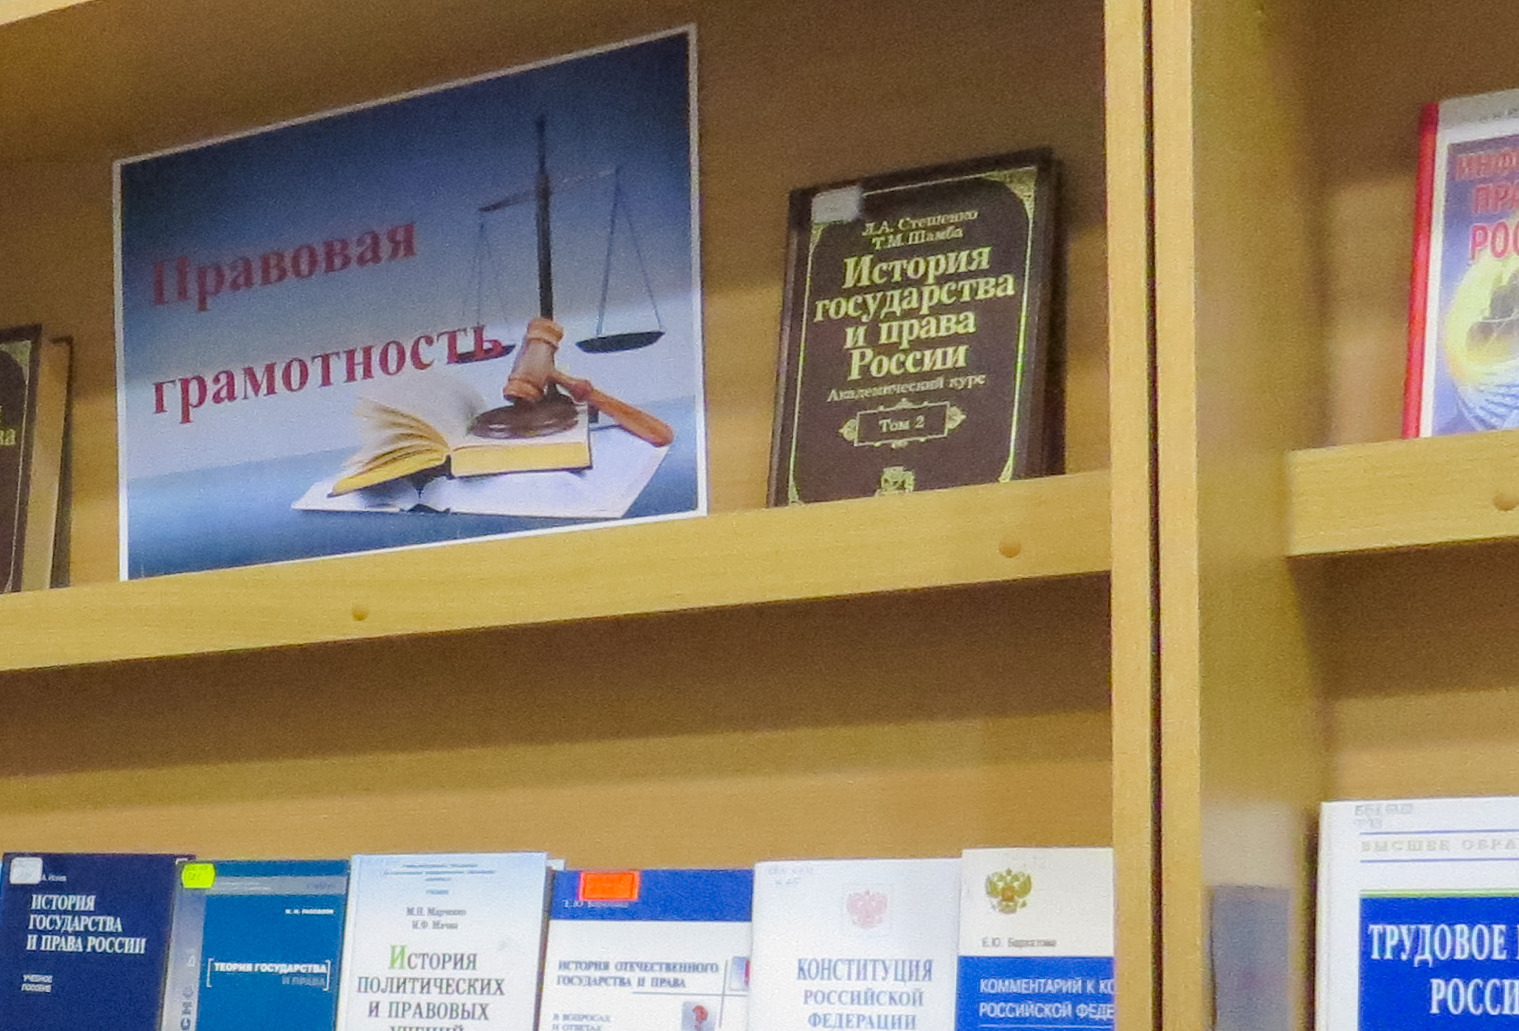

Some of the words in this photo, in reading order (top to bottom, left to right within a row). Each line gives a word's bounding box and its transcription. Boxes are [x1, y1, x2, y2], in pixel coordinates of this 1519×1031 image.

[152, 222, 417, 313] Правовая
[842, 247, 992, 289] История
[813, 273, 1016, 322] государства
[843, 326, 866, 349] и
[878, 311, 977, 349] права
[847, 345, 970, 381] России
[152, 323, 504, 424] грамотность
[948, 372, 987, 393] курс
[879, 417, 912, 434] Том
[914, 416, 925, 429] 2
[31, 893, 96, 912] ИСТОРИЯ
[28, 914, 123, 933] ГОСУДАРСТВА
[26, 934, 38, 951] И
[40, 935, 84, 953] ПРАВА
[86, 936, 147, 955] РОССИИ
[1369, 924, 1507, 968] ТРУДОВОЕ
[213, 962, 253, 972] ТЕОРИЯ
[254, 963, 328, 974] ГОСУДАРСТВА
[558, 960, 610, 972] ИСТОРИЯ
[614, 960, 720, 974] ОТЕЧЕСТВЕННОГО
[796, 957, 934, 983] КОНСТИТУЦИЯ
[356, 976, 506, 996] ПОЛИТИЧЕСКИХ
[556, 975, 631, 988] ГОСУДАРСТВА
[637, 977, 646, 987] И
[650, 977, 687, 989] ПРАВА
[980, 977, 1083, 994] КОММЕНТАРИЙ
[1086, 979, 1095, 994] К
[802, 986, 924, 1008] РОССИЙСКОЙ
[367, 1001, 380, 1018] И
[388, 1001, 490, 1021] ПРАВОВЫХ
[978, 1001, 1073, 1018] РОССИЙСКОЙ
[807, 1012, 918, 1031] ФЕДЕРАЦИИ
